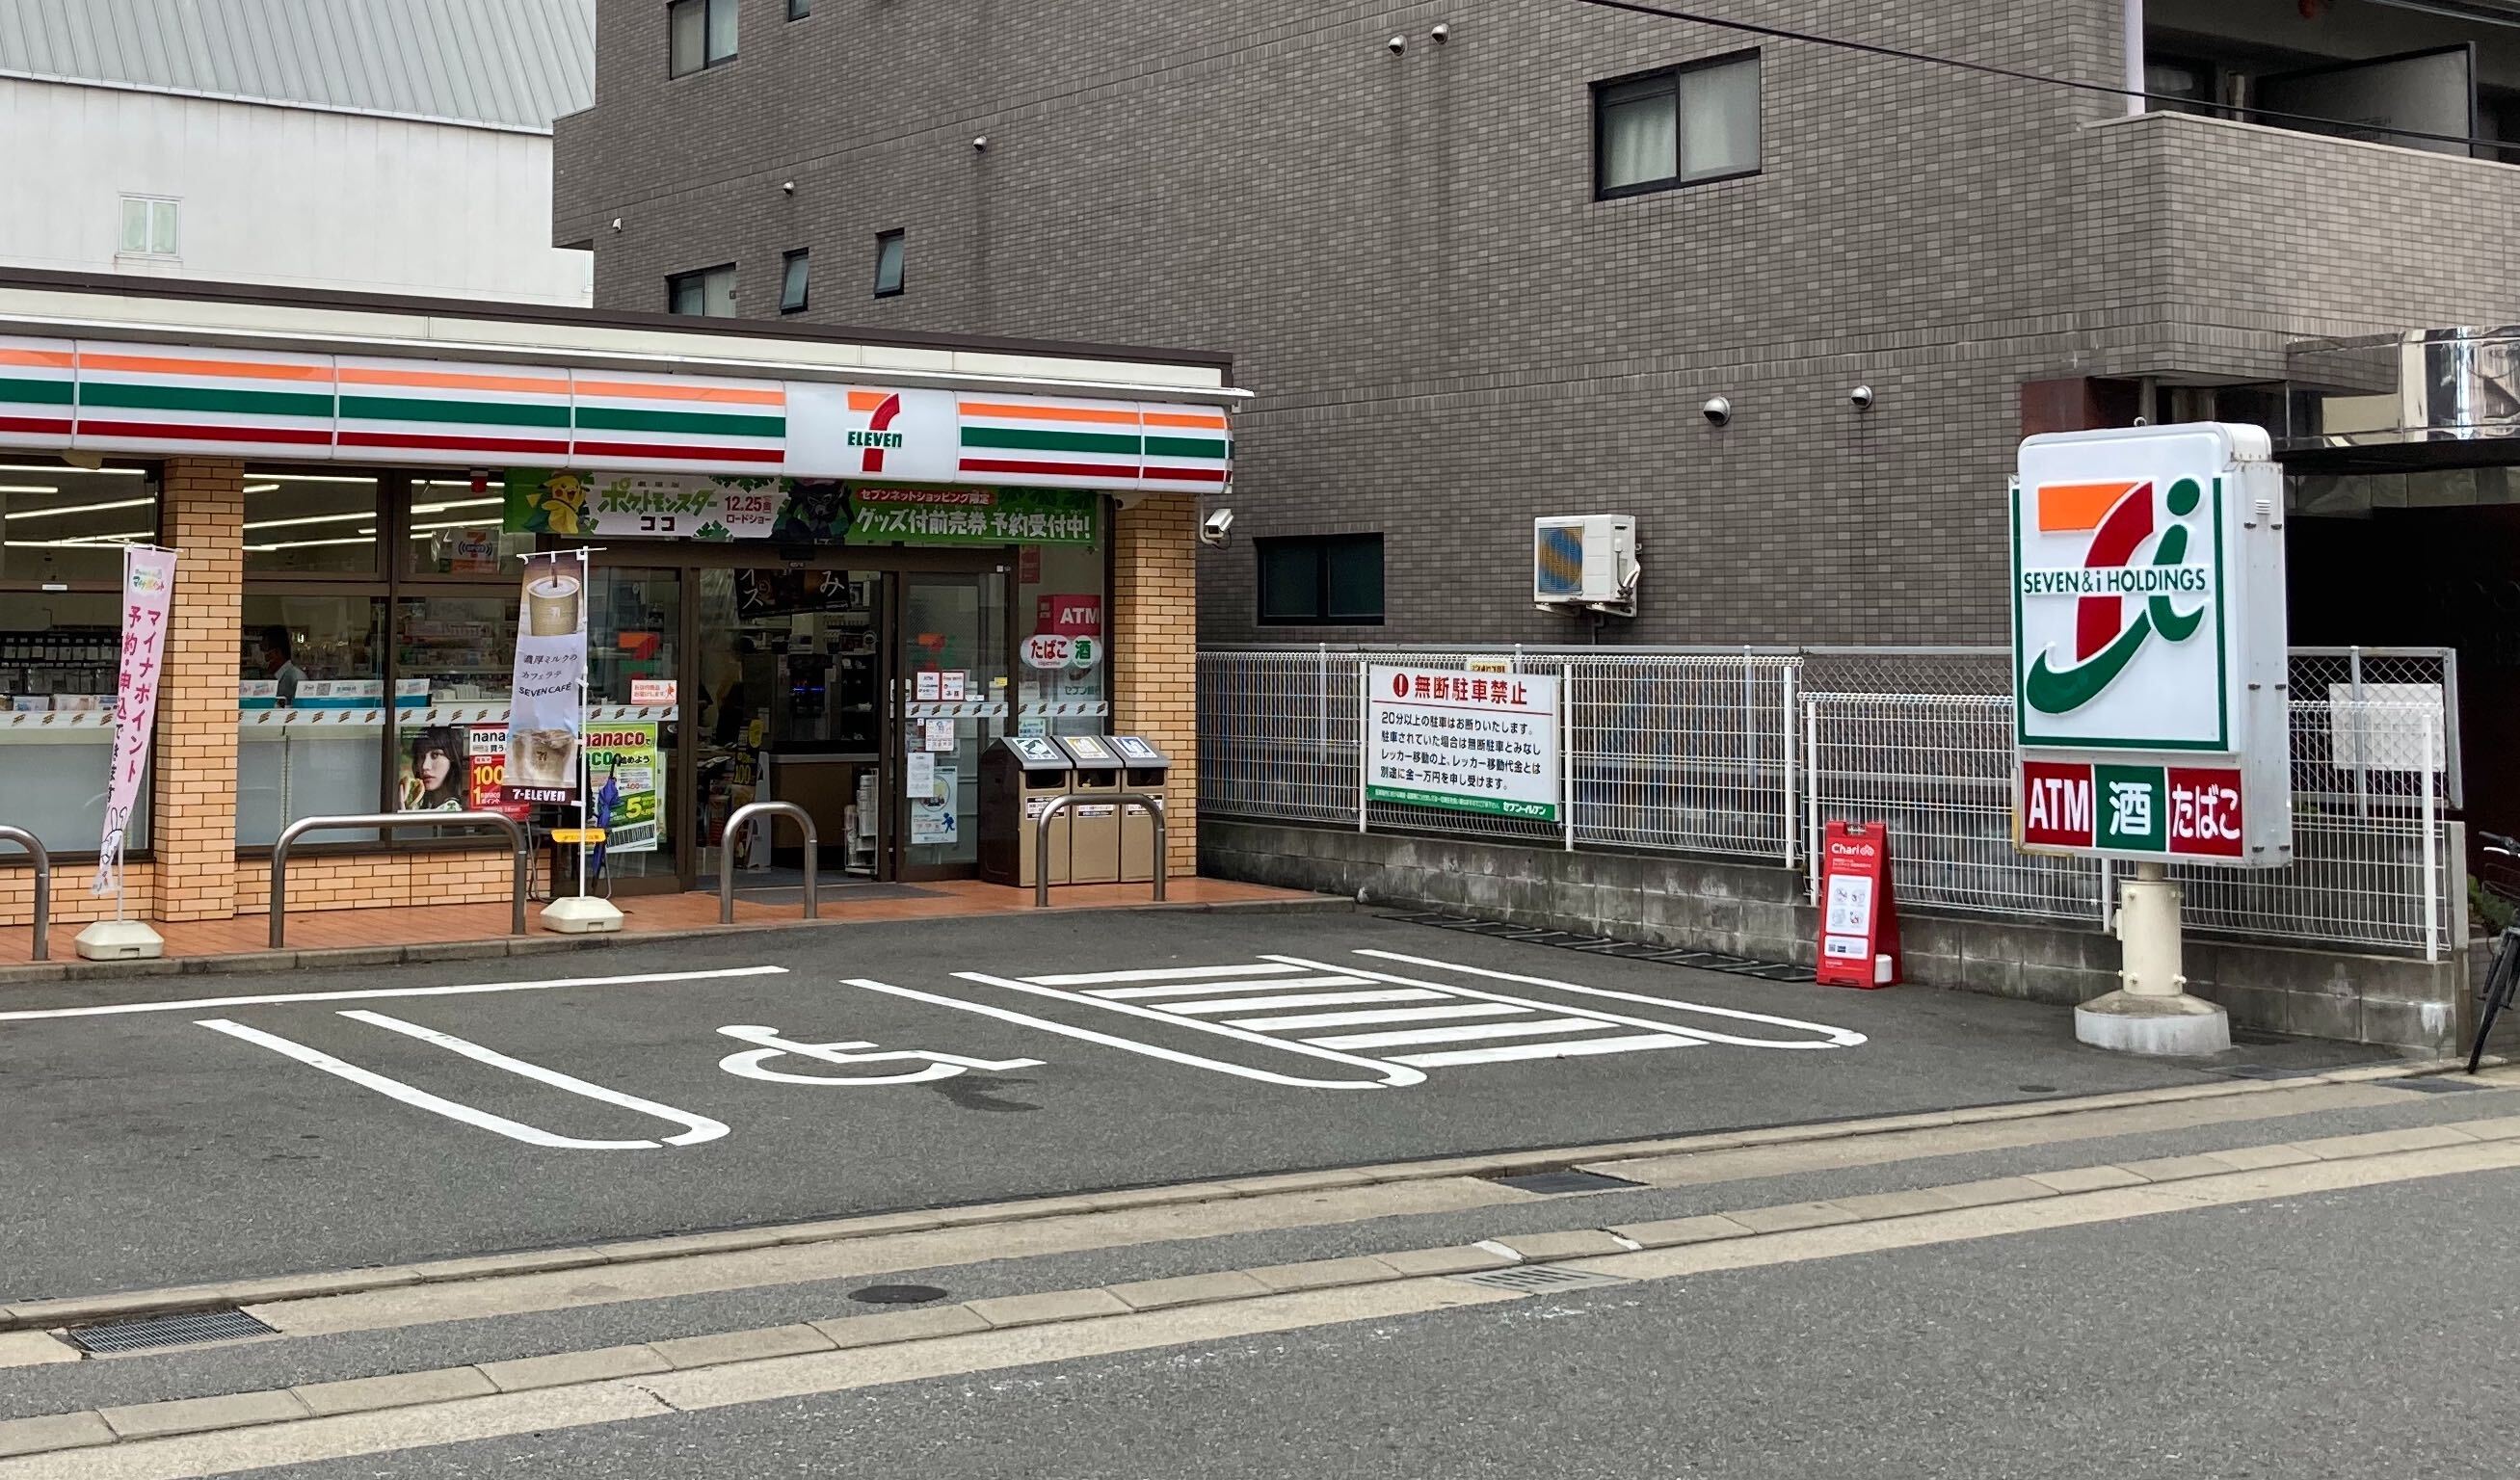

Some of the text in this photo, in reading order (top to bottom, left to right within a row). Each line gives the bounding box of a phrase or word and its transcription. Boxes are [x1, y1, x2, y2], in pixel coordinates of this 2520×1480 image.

[597, 477, 718, 516] ポケットモンスター
[641, 516, 676, 531] ココ
[726, 514, 772, 524] ロードショー
[2108, 568, 2207, 593] HOLDINGS
[523, 654, 578, 665] 濃厚ミルクの
[1030, 640, 1092, 660] たばこ 酒
[521, 670, 562, 679] カフェラテ
[129, 609, 162, 783] マイナポイント
[1414, 674, 1528, 705] 無断駐車禁止
[1381, 711, 1533, 735] 20分以上の駐車はお断りいたします。
[1381, 730, 1542, 755] 駐車されていた場合は無断駐車とみなし
[1381, 750, 1541, 775] レッカー移動の上、レッカー移動代金とは
[1380, 767, 1508, 790] 別途に金一万円を申し受けます。
[2029, 777, 2089, 832] ATM
[2109, 781, 2153, 836] 酒
[2171, 783, 2241, 839] たばこ
